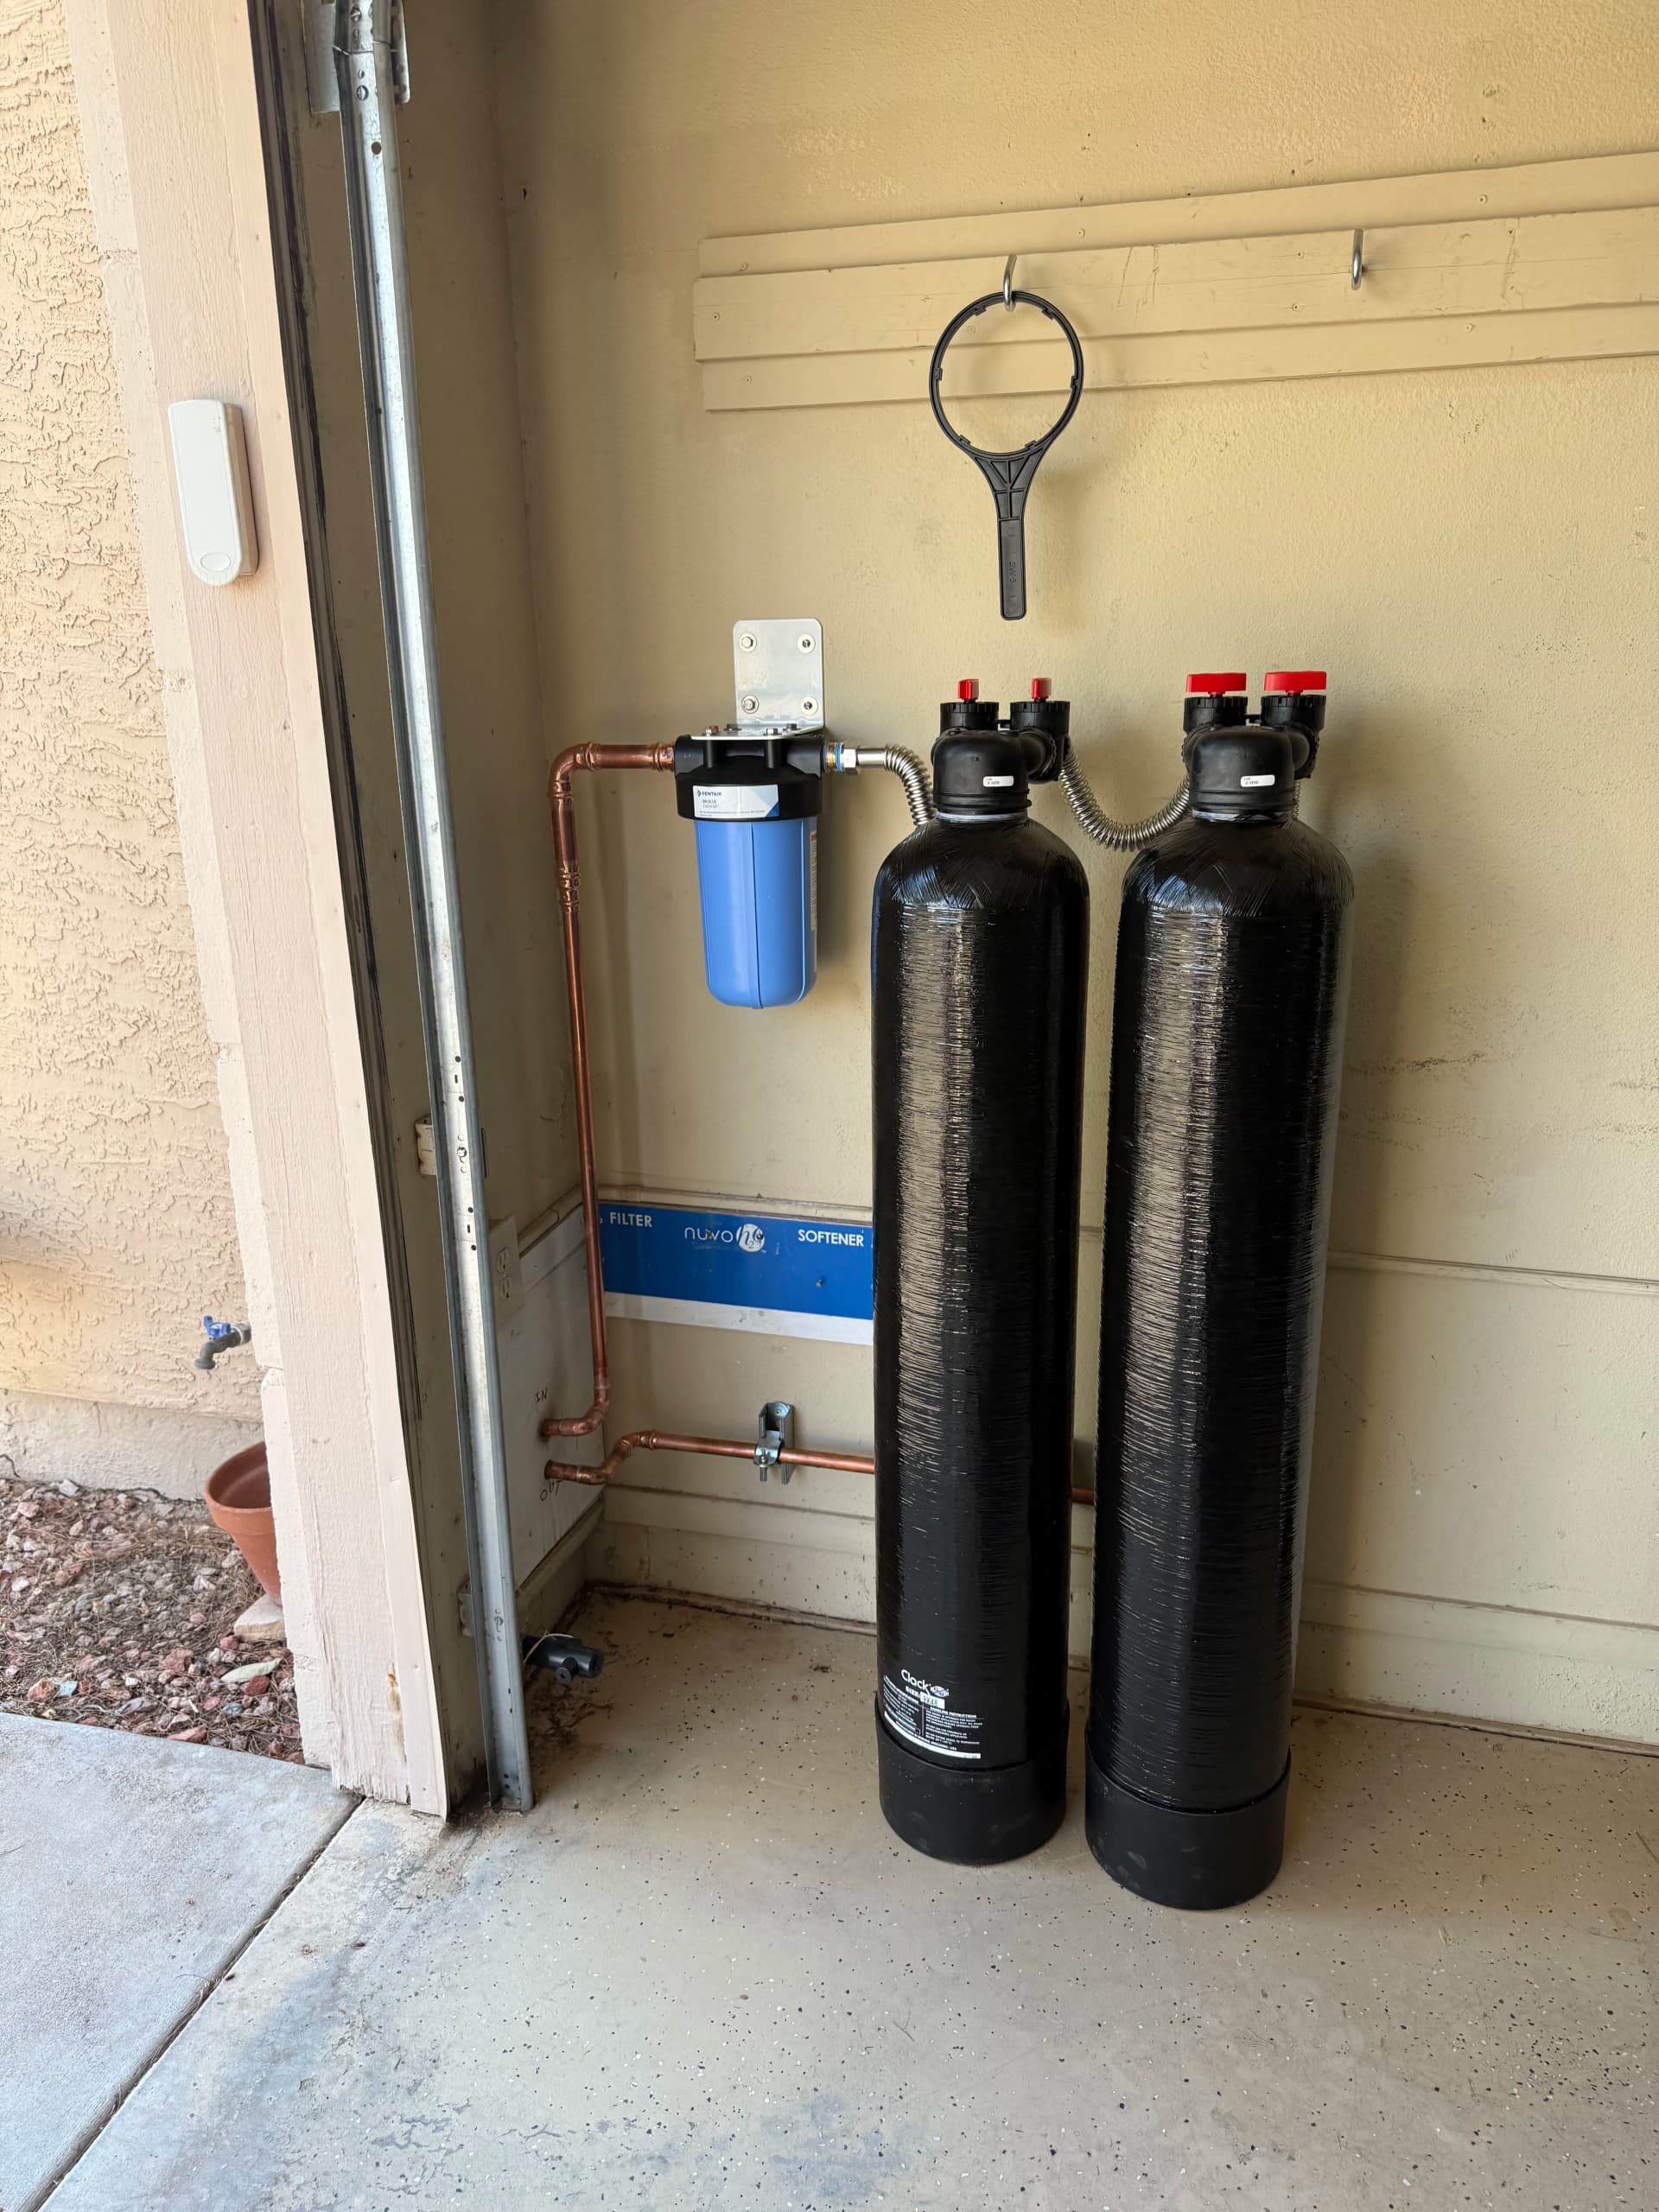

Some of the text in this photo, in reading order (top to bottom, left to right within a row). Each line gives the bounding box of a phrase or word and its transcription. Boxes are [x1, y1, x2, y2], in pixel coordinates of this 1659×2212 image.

[609, 1211, 652, 1228] FILTER
[798, 1229, 864, 1247] SOFTENER
[535, 1386, 548, 1403] IN
[540, 1479, 563, 1502] OUT
[900, 1669, 931, 1695] Clack
